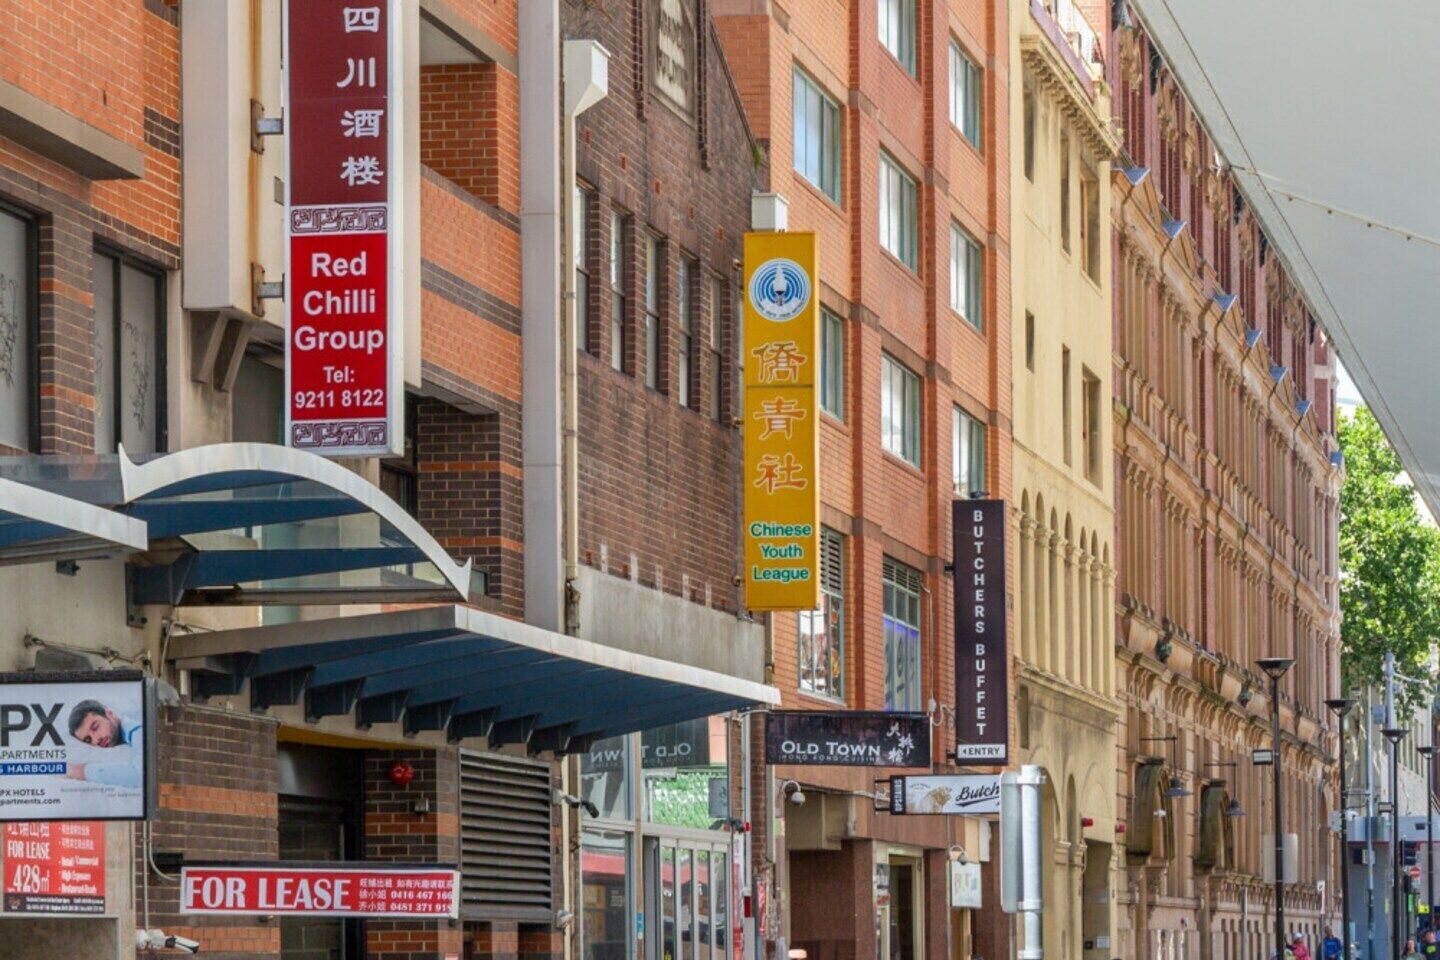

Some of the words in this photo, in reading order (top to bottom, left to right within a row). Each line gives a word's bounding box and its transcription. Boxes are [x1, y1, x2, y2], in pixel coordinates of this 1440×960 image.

[336, 6, 384, 187] 四川酒楼
[310, 250, 367, 277] Red
[303, 289, 376, 316] Chilli
[294, 325, 384, 355] Group
[323, 366, 355, 384] Tel:
[295, 391, 335, 409] 9211
[341, 389, 384, 407] 8122
[750, 523, 812, 538] Chinese
[760, 544, 804, 559] Youth
[753, 566, 810, 581] League
[972, 509, 986, 634] BUTCHERS
[974, 643, 987, 737] BUFFET
[0, 748, 67, 760] PARTMENTS
[825, 741, 882, 757] TOWN
[968, 745, 1000, 757] ENTRY
[7, 763, 64, 774] HARBOUR
[13, 788, 46, 797] HOTELS
[8, 840, 24, 858] FOR
[26, 841, 50, 860] LEASE
[185, 876, 247, 908] FOR
[258, 877, 352, 910] LEASE
[415, 902, 433, 911] 371
